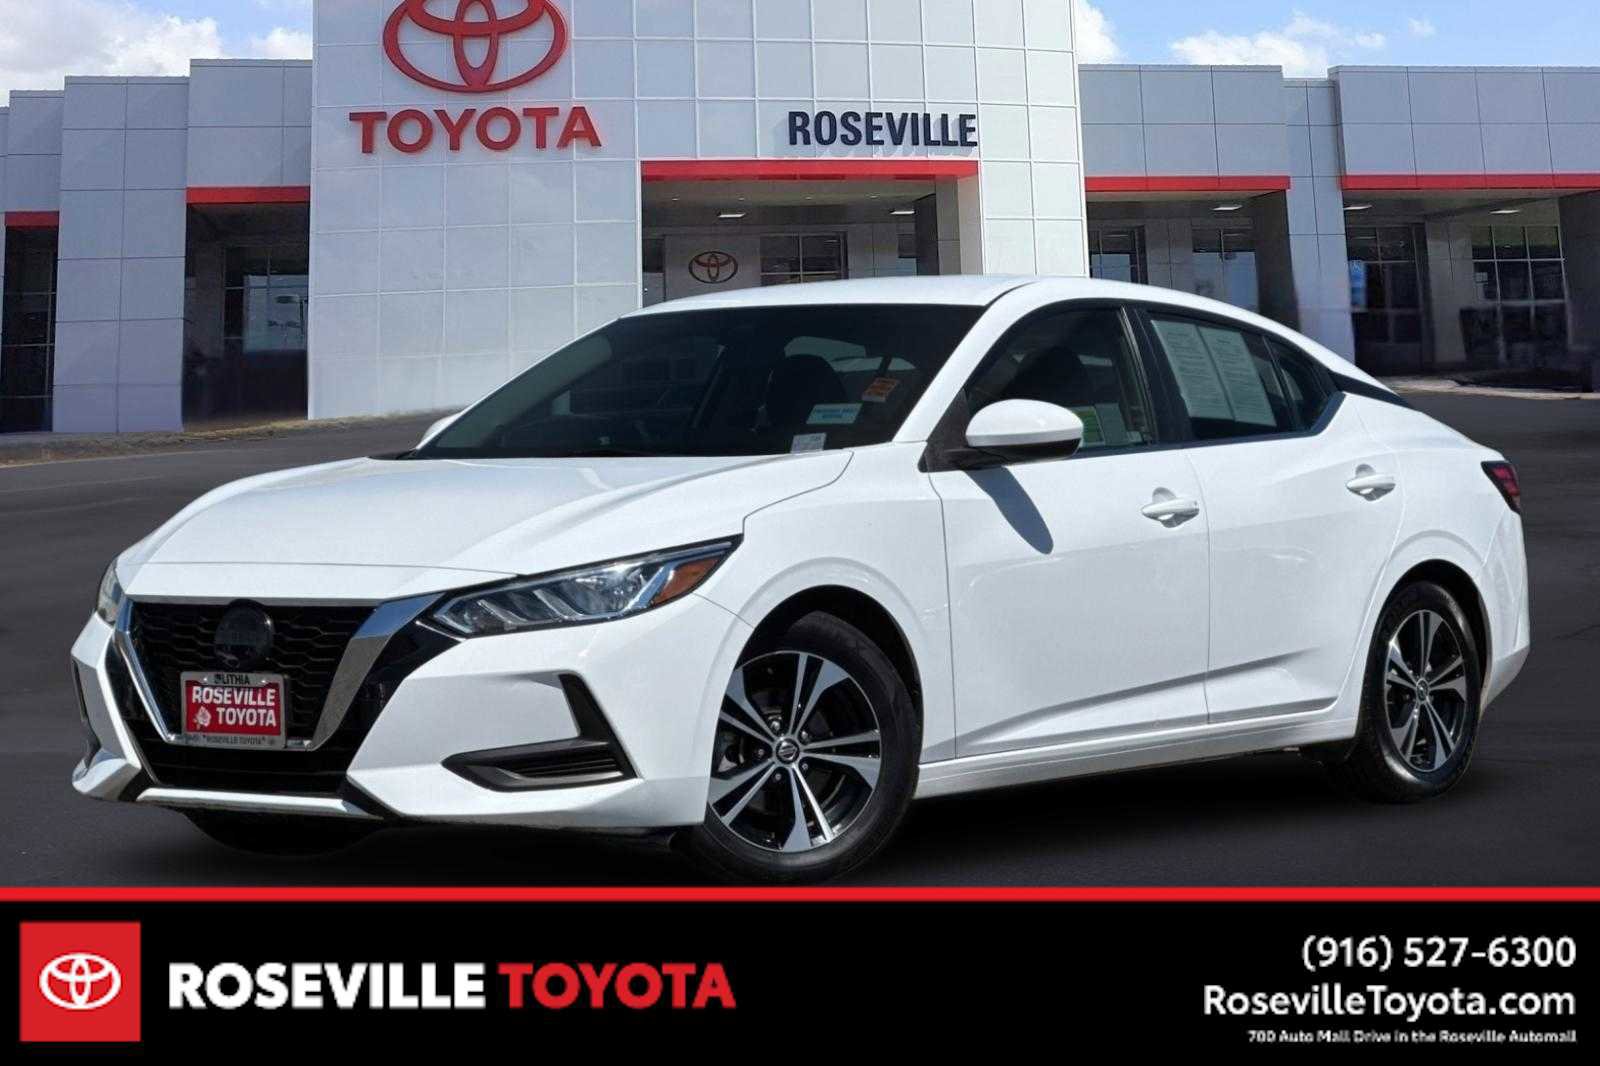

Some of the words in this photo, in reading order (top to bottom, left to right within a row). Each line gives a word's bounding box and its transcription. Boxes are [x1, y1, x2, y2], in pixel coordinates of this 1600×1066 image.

[350, 106, 602, 154] TOYOTA
[789, 111, 978, 147] ROSEVILLE
[223, 674, 250, 685] LITHIA
[192, 686, 276, 706] ROSEVILLE
[216, 707, 277, 727] TOYOTA
